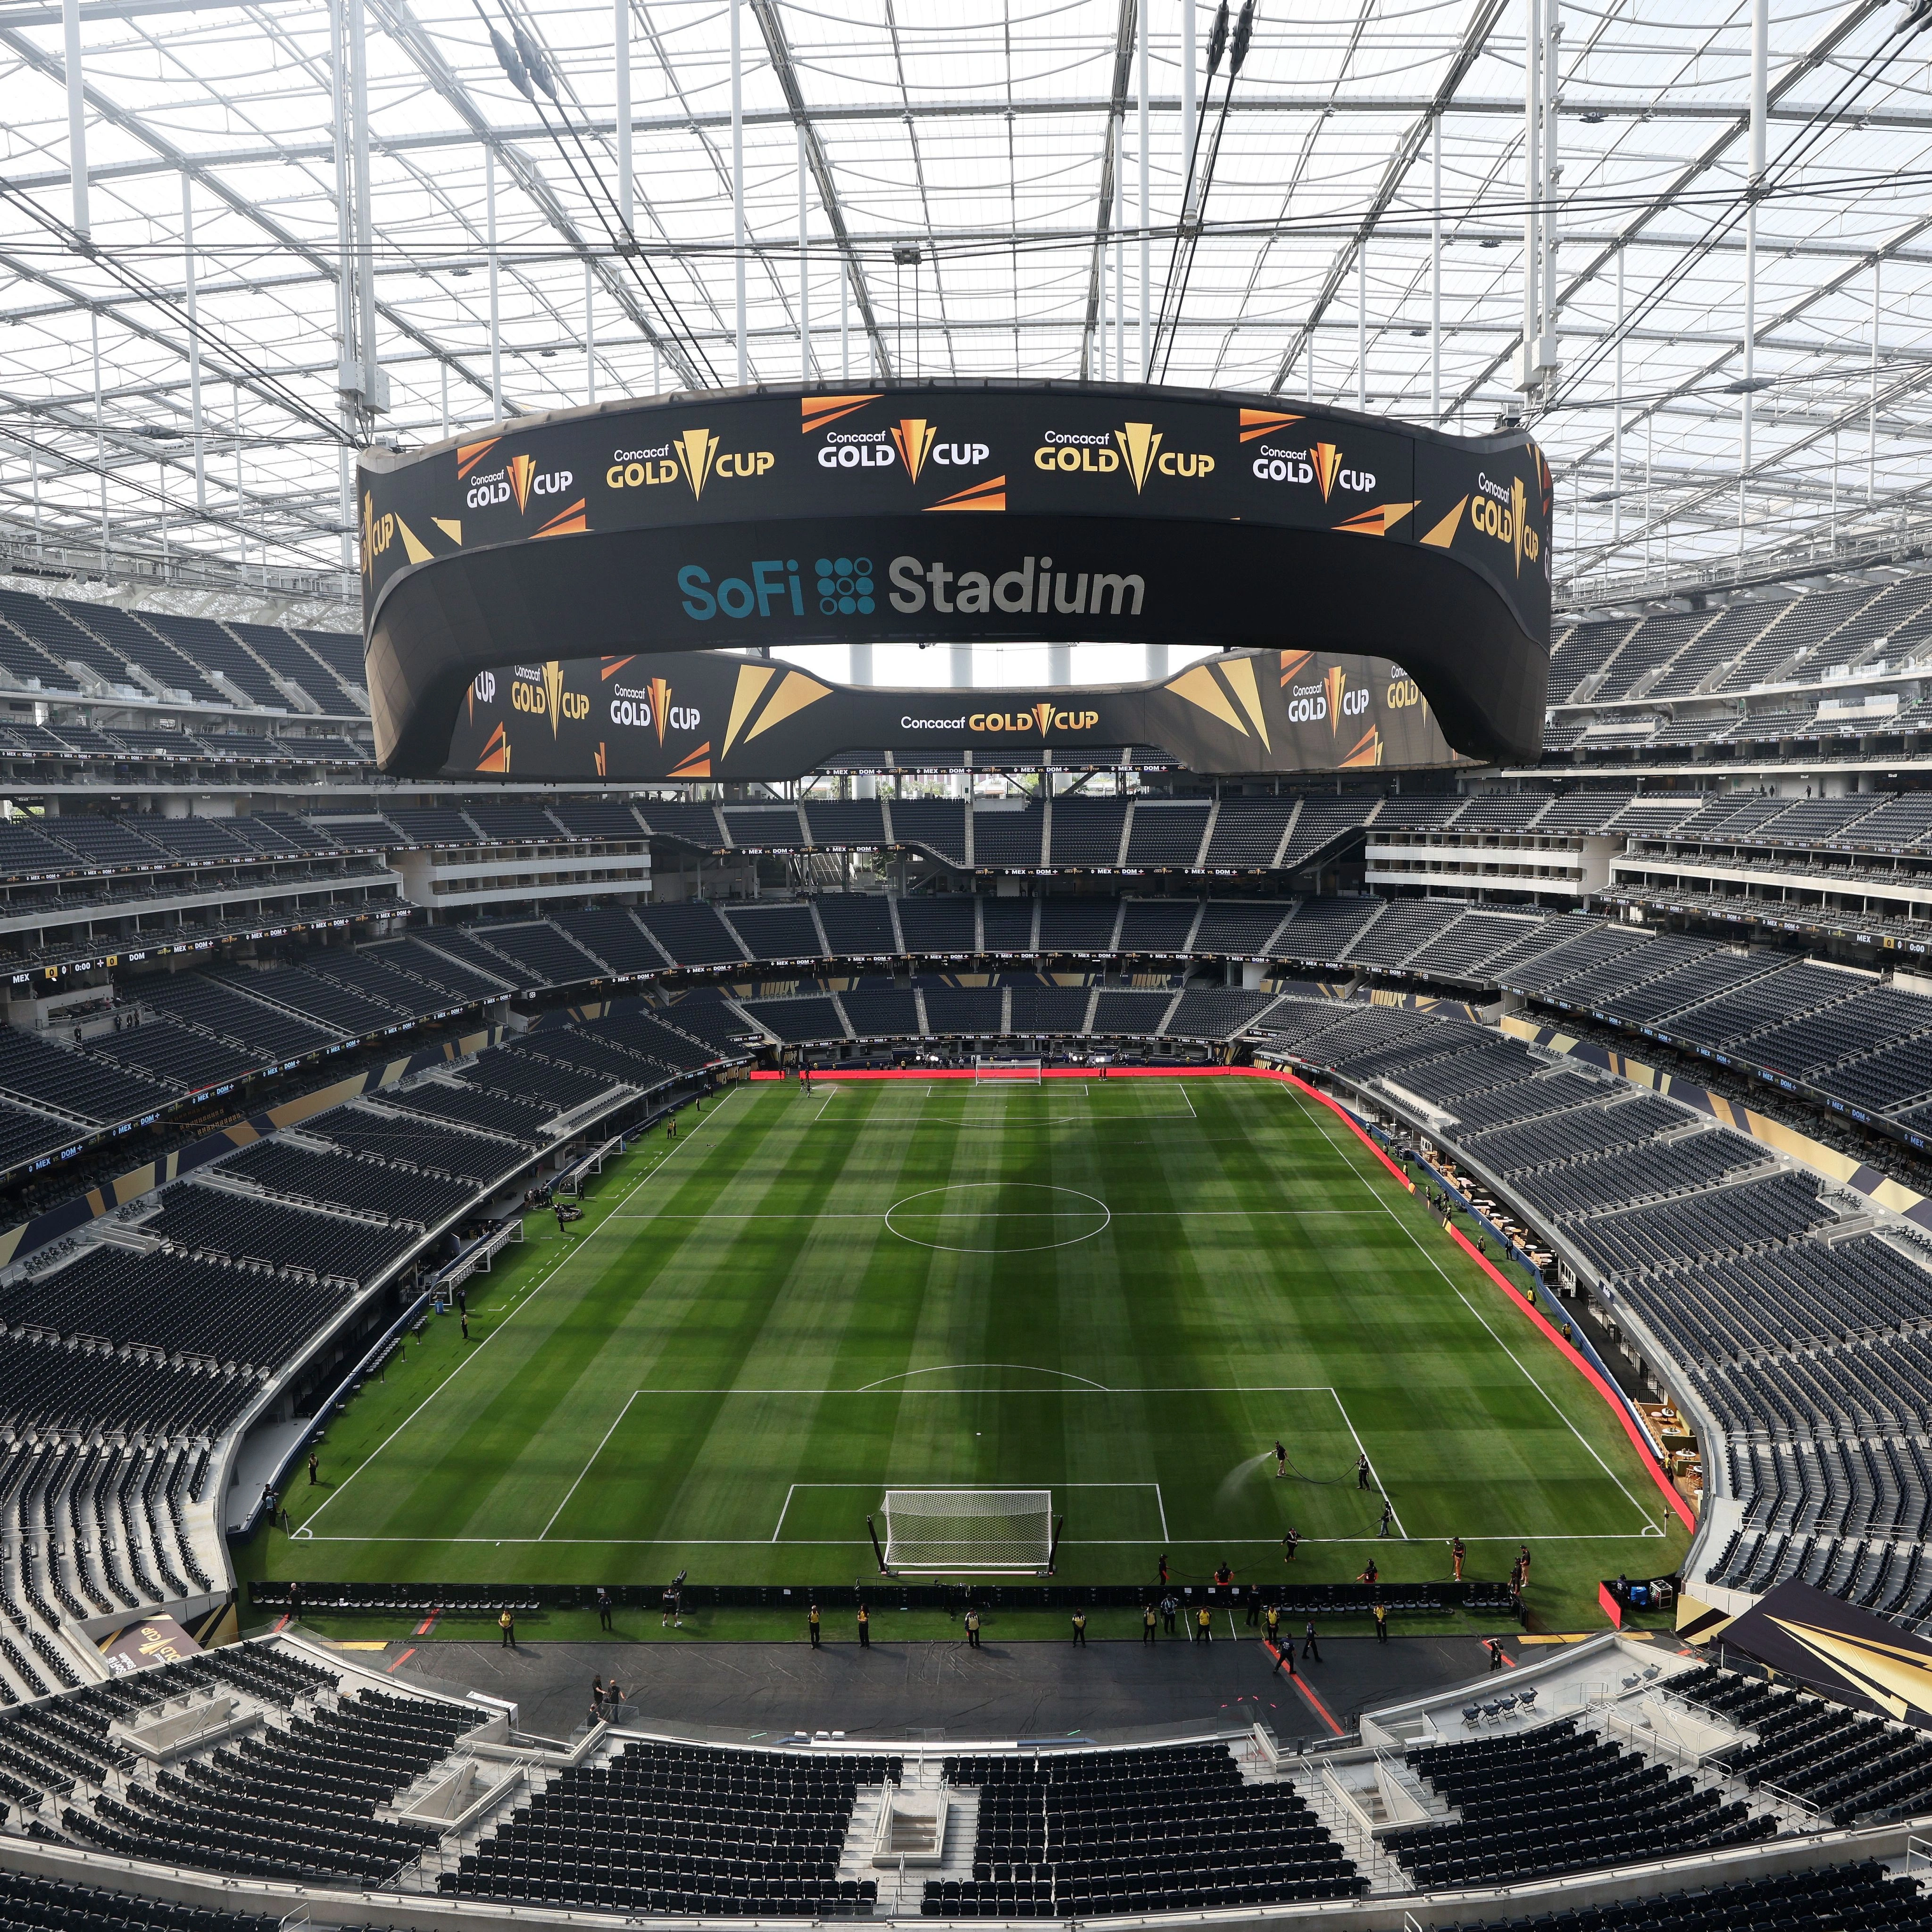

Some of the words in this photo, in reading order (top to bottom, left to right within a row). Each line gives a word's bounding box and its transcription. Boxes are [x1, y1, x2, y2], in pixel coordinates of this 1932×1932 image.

[827, 431, 885, 443] Concacaf
[1045, 431, 1109, 445] Concacaf
[614, 444, 669, 461] Concacaf
[818, 445, 895, 467] GOLD
[933, 444, 989, 465] CUP
[1034, 447, 1119, 472] GOLD
[1158, 452, 1215, 477] CUP
[1260, 445, 1307, 460] Concacaf
[471, 469, 504, 486] Concacaf
[607, 460, 678, 488] GOLD
[716, 452, 774, 477] CUP
[1253, 459, 1313, 483] GOLD
[1339, 469, 1375, 492] CUP
[467, 483, 510, 508] GOLD
[533, 471, 573, 494] CUP
[1479, 472, 1509, 503] Concacaf
[373, 513, 393, 556] CUP
[1472, 495, 1512, 543] GOLD
[1524, 525, 1538, 562] CUP
[678, 559, 804, 620] SoFi
[889, 556, 1145, 615] Stadium
[515, 666, 540, 682] Concacaf
[1391, 665, 1407, 679] Conc
[475, 671, 495, 703] CUP
[615, 683, 645, 700] Concacaf
[1293, 681, 1322, 697] Concacaf
[1387, 679, 1418, 708] GOLD
[512, 681, 545, 714] GOLD
[562, 692, 589, 719] CUP
[1289, 697, 1326, 722] GOLD
[1343, 689, 1369, 715] CUP
[610, 700, 650, 726] GOLD
[670, 707, 700, 730] CUP
[901, 716, 965, 728] Concacaf
[969, 714, 1033, 731] GOLD
[1055, 711, 1098, 729] CUP
[1857, 934, 1871, 943] MEX
[1910, 944, 1924, 952] 0:00
[13, 974, 30, 983] MEX
[75, 962, 91, 971] 0:00
[129, 952, 145, 961] DOM
[268, 1066, 278, 1075] MEX
[284, 1061, 295, 1069] DOM
[1763, 1072, 1773, 1081] MEX
[1781, 1078, 1791, 1089] DOM
[198, 1092, 208, 1102] MEX
[217, 1085, 229, 1094] DOM
[1832, 1101, 1843, 1111] MEX
[1852, 1109, 1865, 1120] DOM
[119, 1123, 132, 1134] MEX
[141, 1115, 154, 1124] DOM
[1911, 1135, 1923, 1148] MEX
[36, 1157, 50, 1169] MEX
[61, 1147, 76, 1158] DOM
[141, 1628, 161, 1641] CUP
[160, 1647, 181, 1661] OLD
